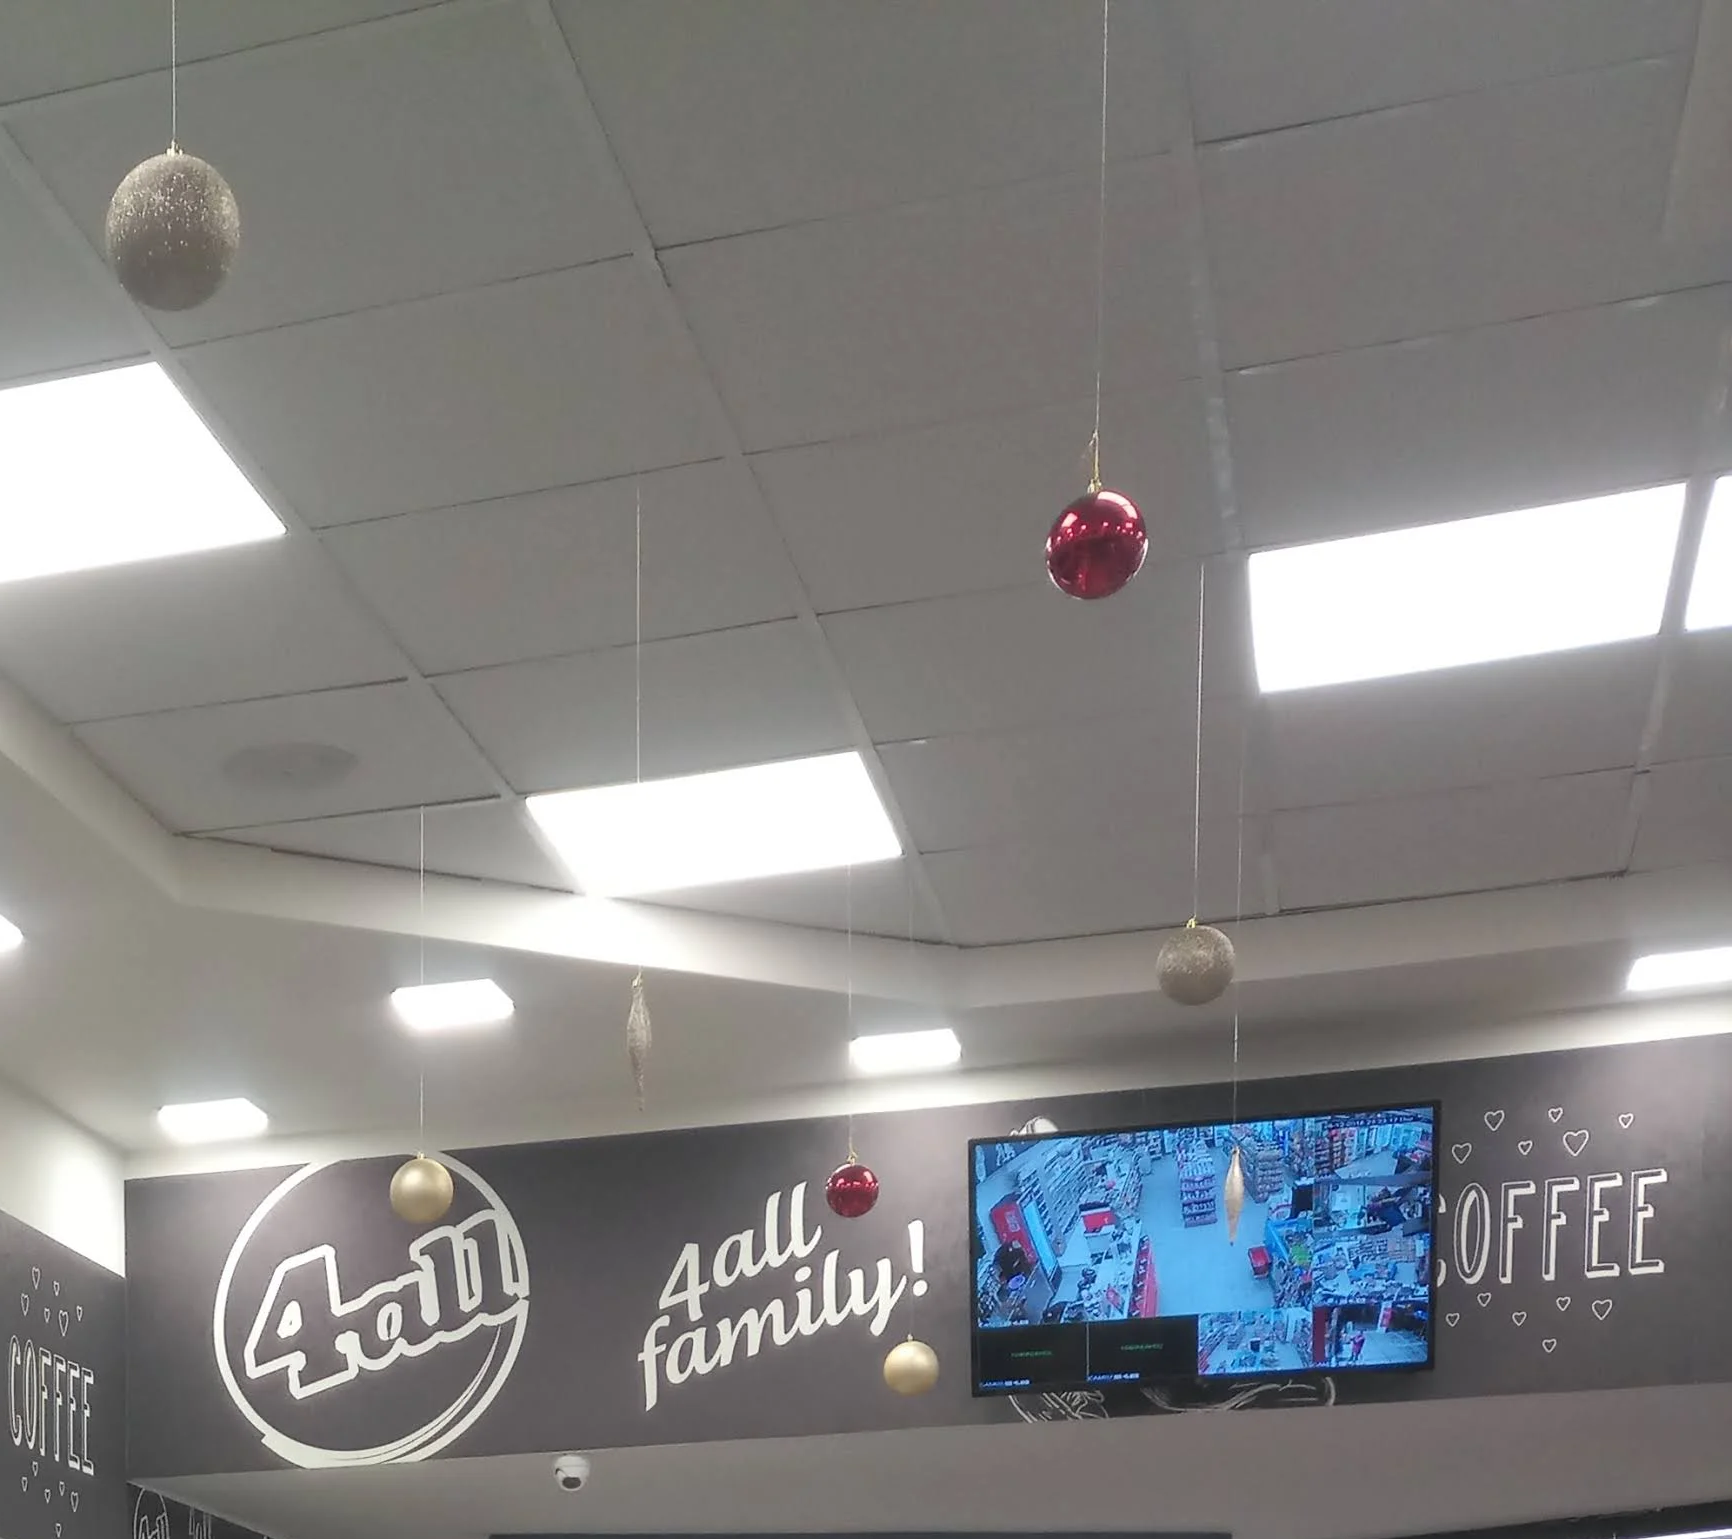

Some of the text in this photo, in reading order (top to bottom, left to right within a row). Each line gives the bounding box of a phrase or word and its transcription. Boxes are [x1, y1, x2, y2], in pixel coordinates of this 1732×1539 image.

[244, 1206, 525, 1401] 4all
[637, 1219, 930, 1411] family!
[658, 1181, 822, 1321] 4all
[7, 1335, 95, 1477] COFFEE
